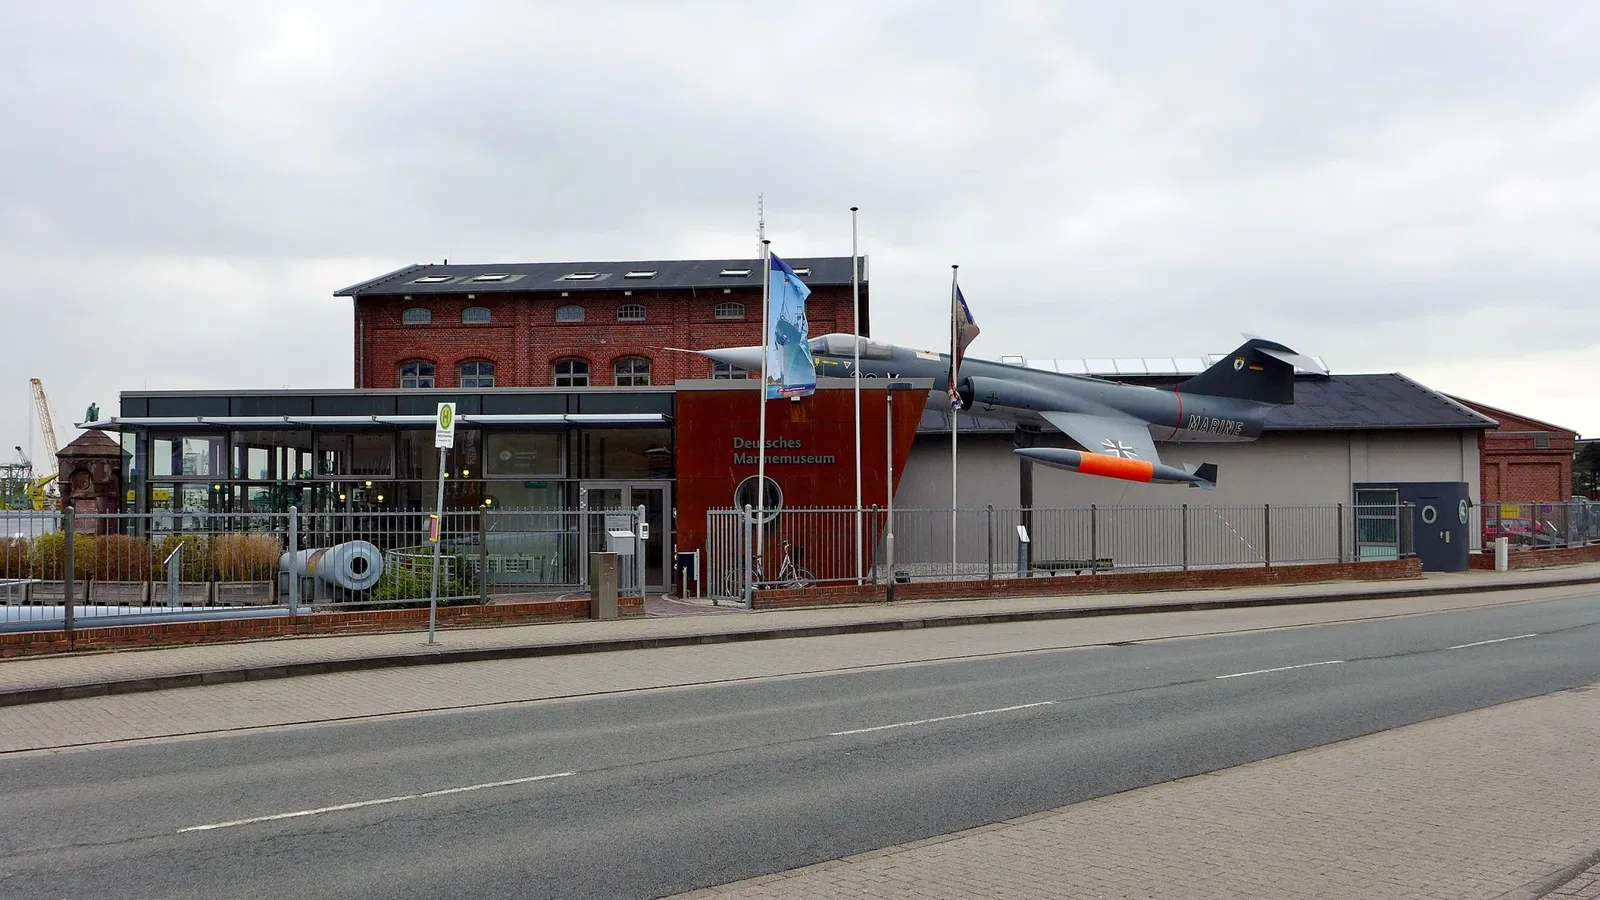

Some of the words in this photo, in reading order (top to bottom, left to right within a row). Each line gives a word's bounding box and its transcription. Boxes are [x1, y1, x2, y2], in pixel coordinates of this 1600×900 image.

[1187, 414, 1244, 436] MARINE
[733, 436, 802, 449] Deusches
[733, 452, 836, 465] Marnemuseum
